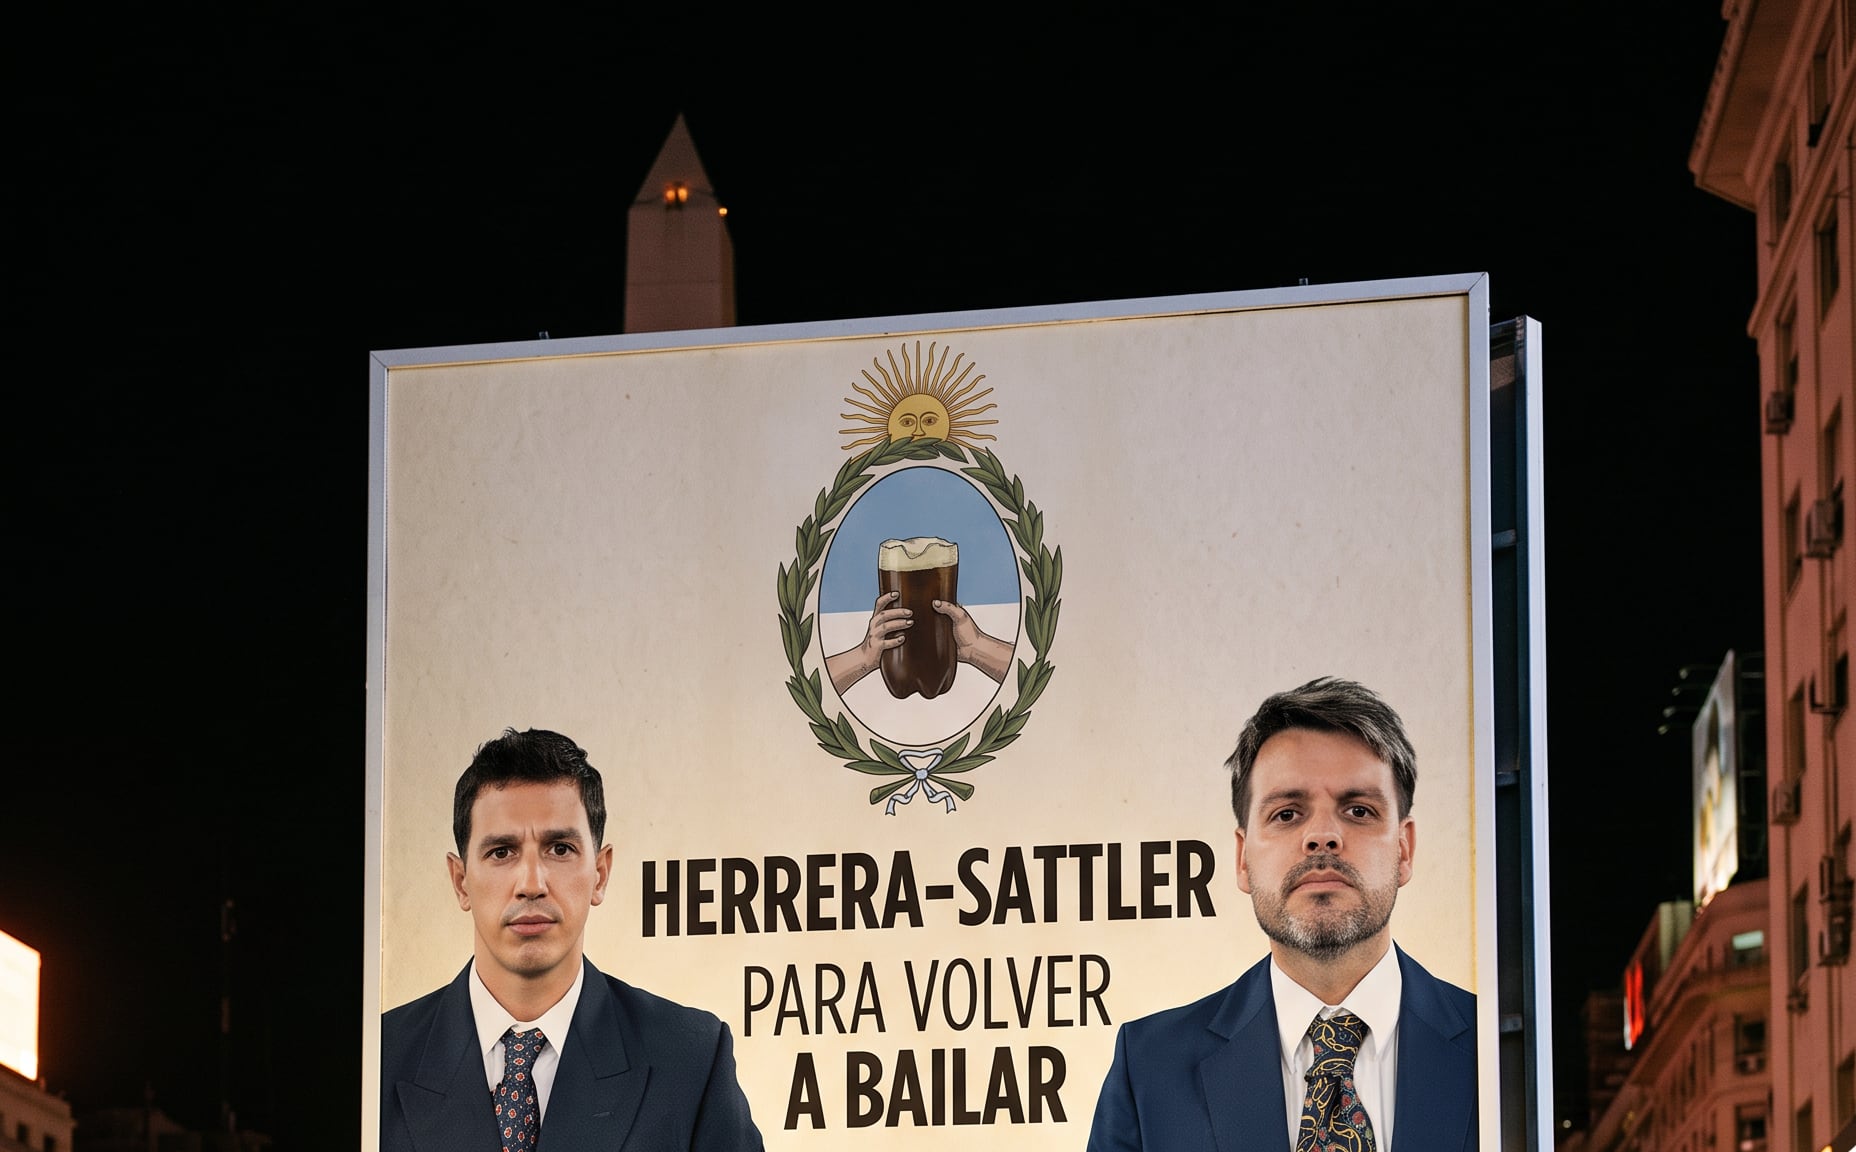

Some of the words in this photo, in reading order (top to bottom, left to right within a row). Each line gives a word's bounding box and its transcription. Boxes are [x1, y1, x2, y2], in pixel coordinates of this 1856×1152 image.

[642, 839, 1217, 938] HERRERA-SATTLER
[743, 961, 887, 1037] PARA
[903, 954, 1113, 1032] VOLVER
[783, 1052, 827, 1131] A
[846, 1045, 1068, 1129] BAILAR
